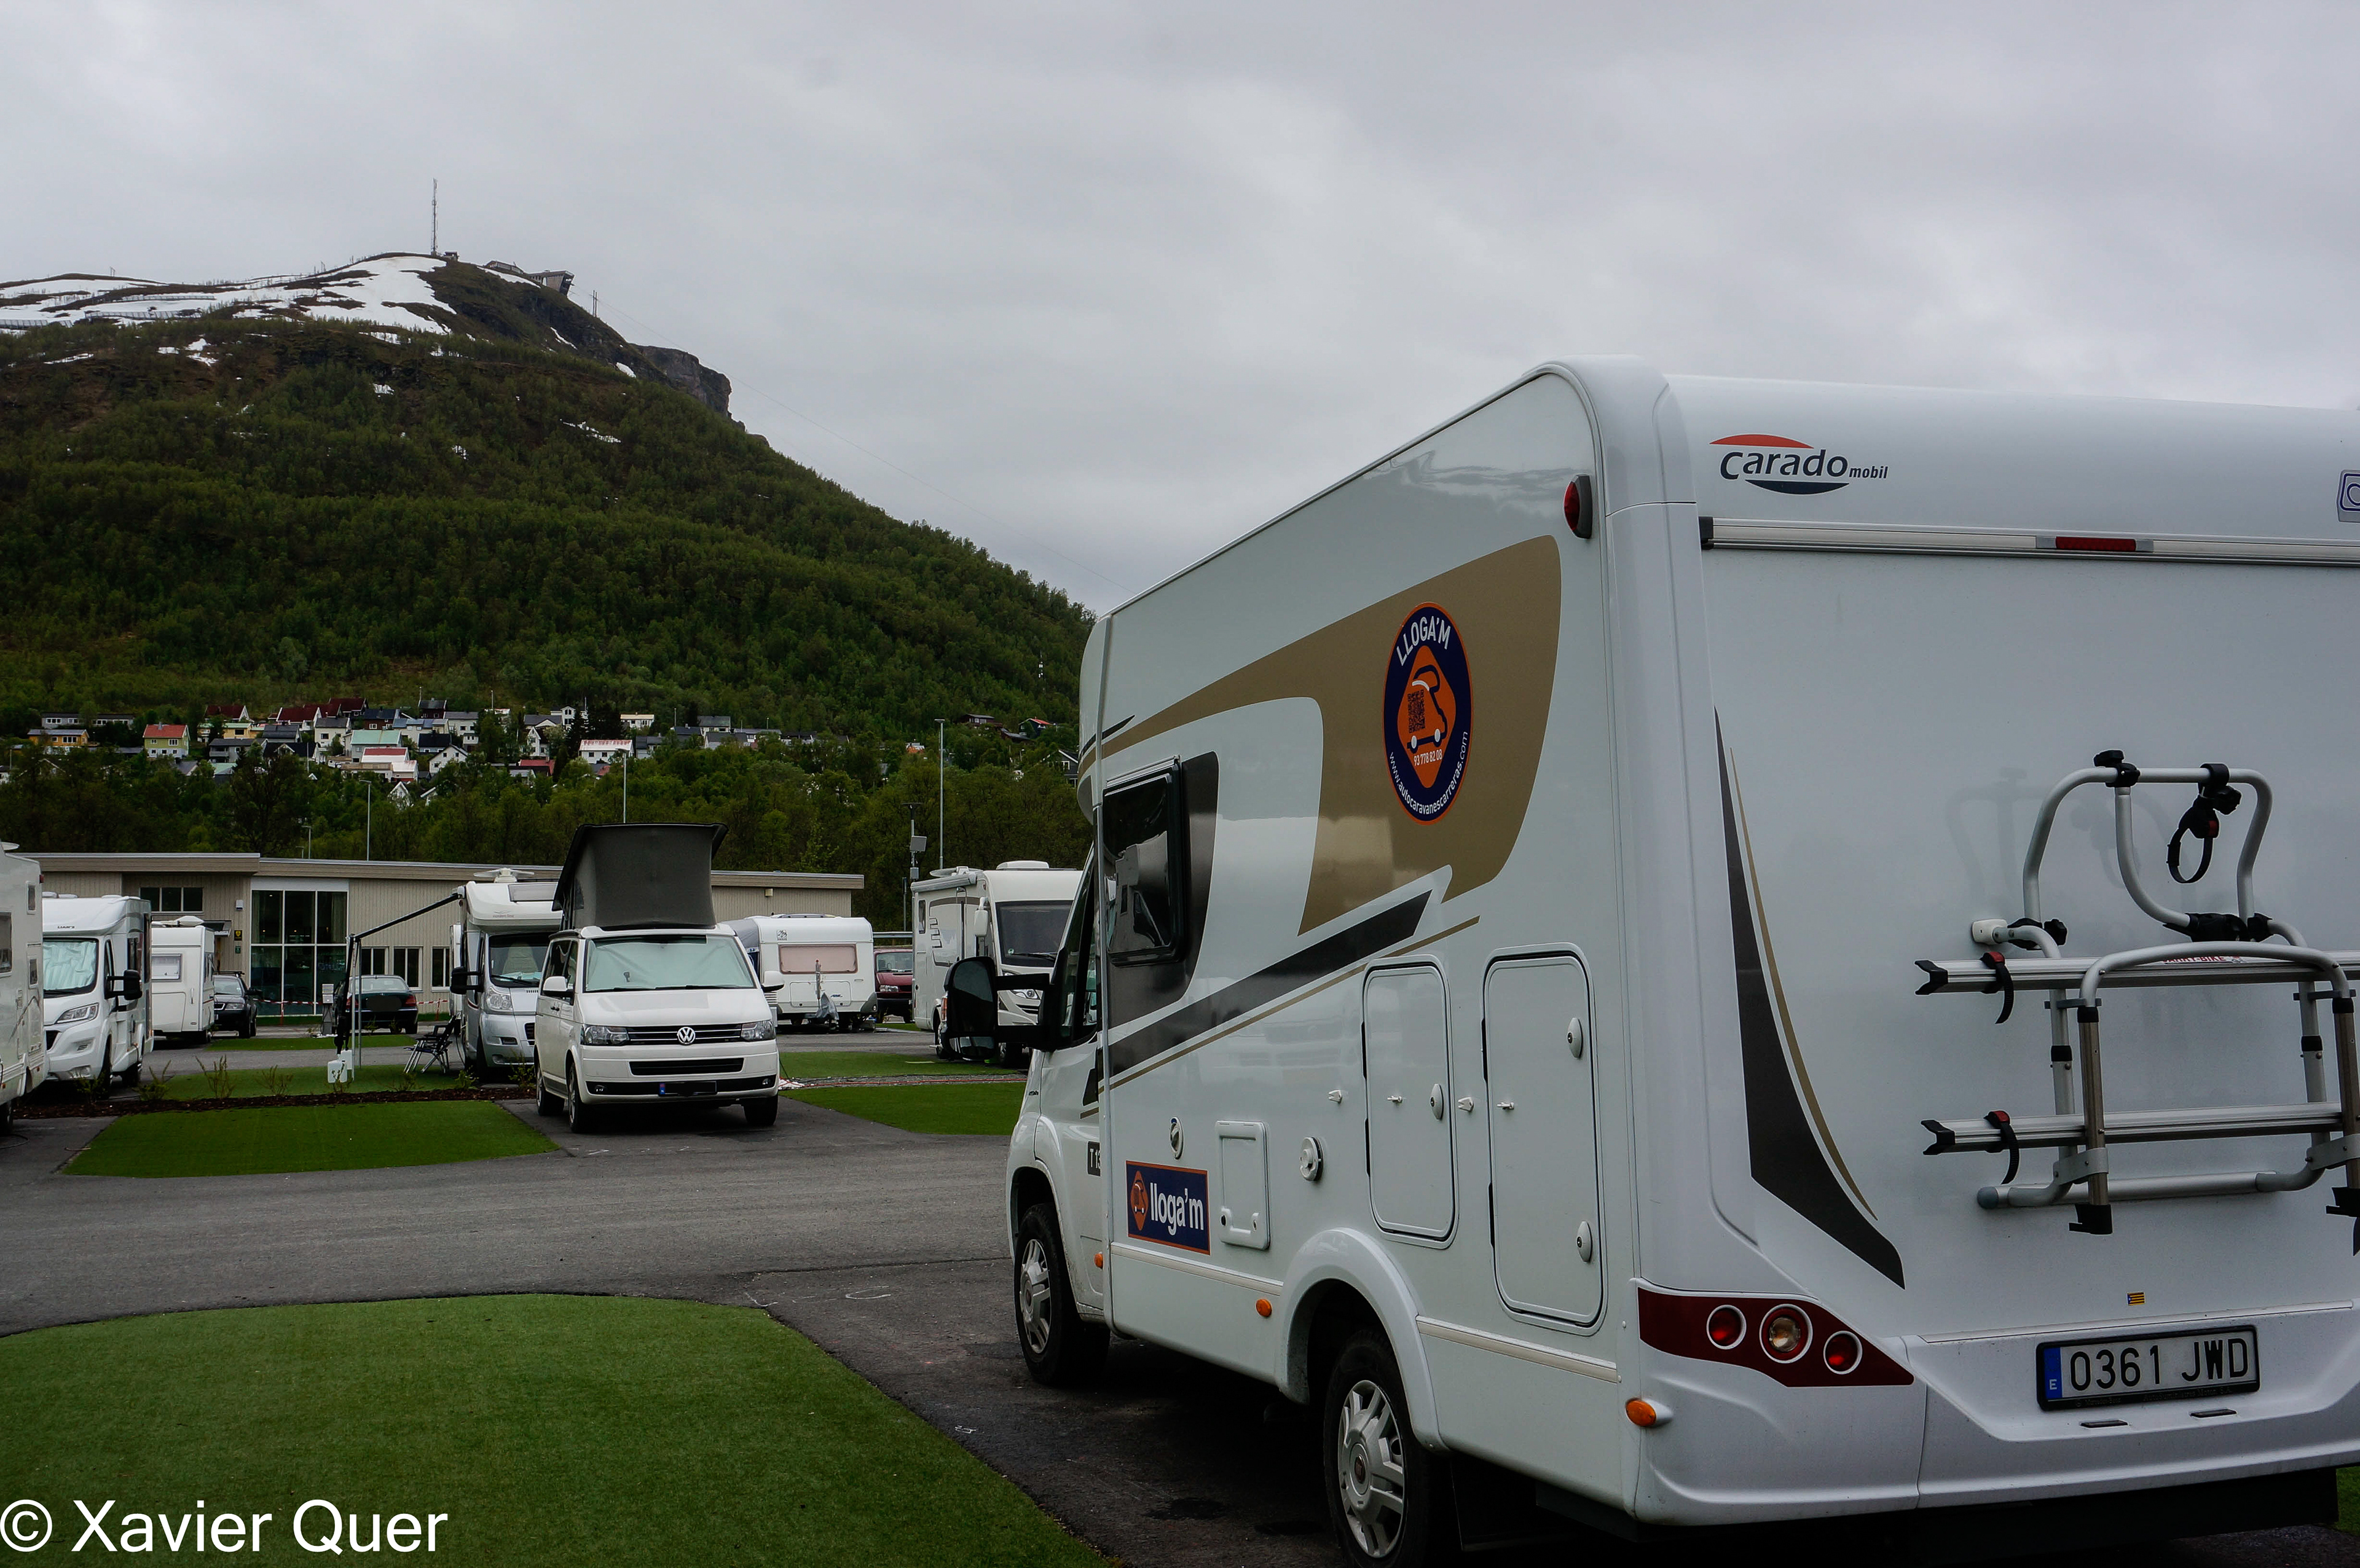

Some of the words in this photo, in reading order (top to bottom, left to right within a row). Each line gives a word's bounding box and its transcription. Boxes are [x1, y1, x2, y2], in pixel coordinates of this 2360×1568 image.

[1720, 449, 1849, 480] carado
[1849, 465, 1889, 479] mobil
[1396, 616, 1451, 666] LLOGA'M
[1390, 731, 1468, 815] www.autocaravanescarreras.com
[1090, 1148, 1094, 1167] T
[1150, 1183, 1204, 1236] lloga'm
[2049, 1379, 2057, 1390] E
[2070, 1345, 2160, 1391] 0361
[2182, 1338, 2248, 1382] JWD
